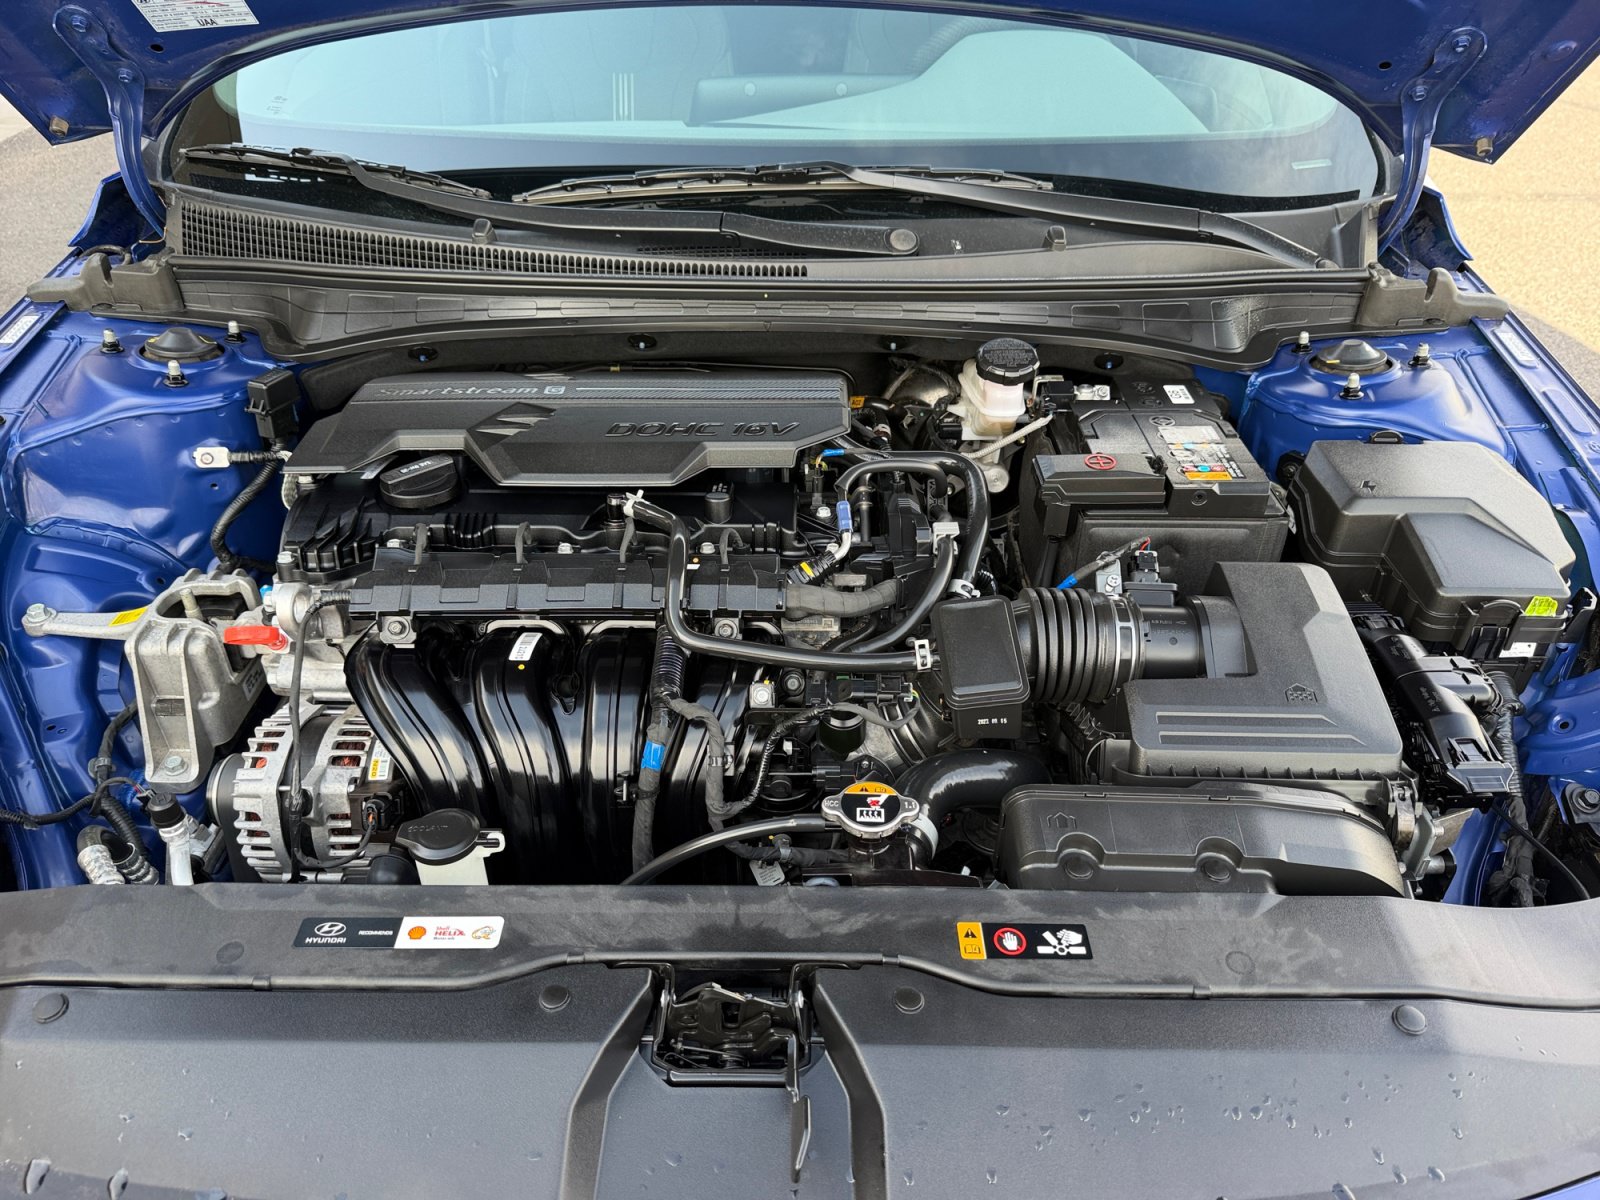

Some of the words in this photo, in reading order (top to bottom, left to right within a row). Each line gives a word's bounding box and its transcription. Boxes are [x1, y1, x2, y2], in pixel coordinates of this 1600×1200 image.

[376, 386, 538, 396] Smartstream
[605, 422, 724, 437] DOHC
[731, 422, 800, 437] 16V
[904, 801, 916, 809] 1.1
